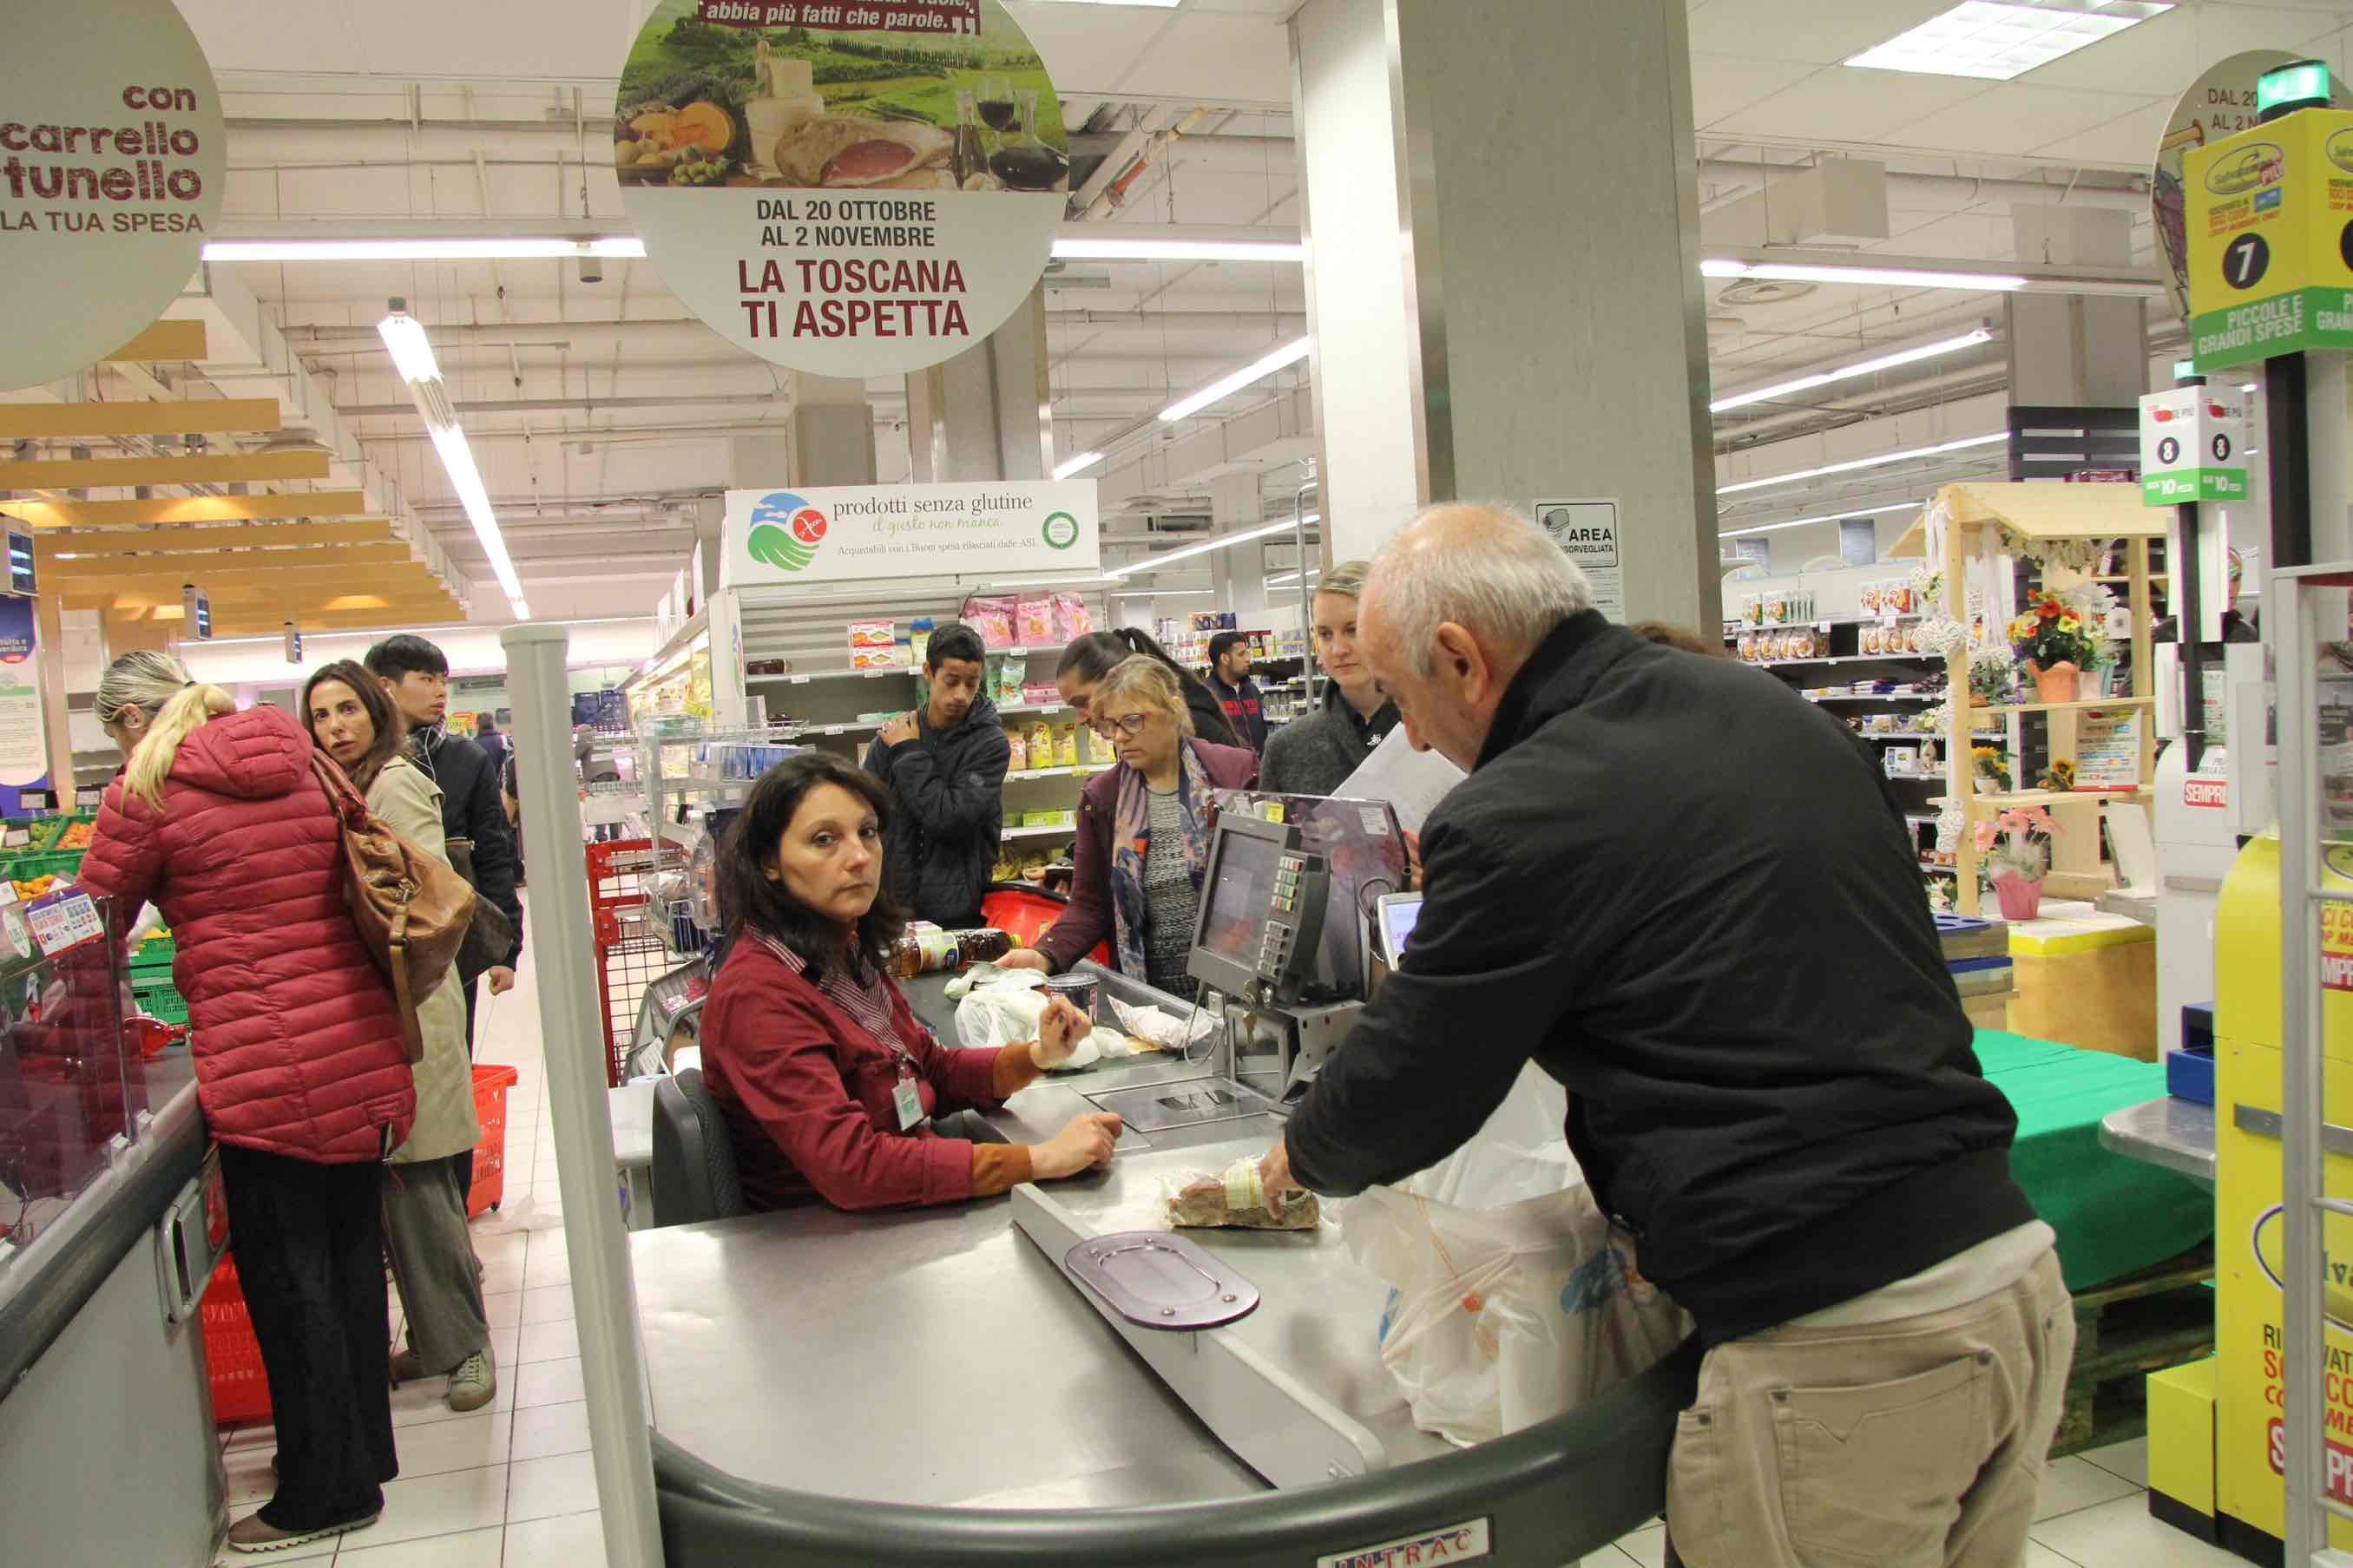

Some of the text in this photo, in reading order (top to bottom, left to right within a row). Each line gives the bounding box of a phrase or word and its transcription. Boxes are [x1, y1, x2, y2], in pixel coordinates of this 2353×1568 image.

[707, 3, 759, 21] abbia
[766, 4, 797, 24] più
[803, 5, 842, 23] fatti
[846, 8, 880, 25] che
[122, 85, 197, 112] con
[2207, 88, 2238, 105] DAL
[2212, 114, 2230, 130] AL
[2235, 115, 2244, 130] 2
[0, 121, 200, 156] carrello
[0, 155, 202, 201] tunello
[756, 200, 937, 221] DAL 20 OTTOBRE
[44, 211, 105, 233] TUA
[112, 213, 205, 233] SPESA
[760, 226, 936, 247] AL 2 NOVEMBRE
[738, 259, 967, 294] LA TOSCANA
[740, 299, 969, 338] TI ASPETTA
[2226, 297, 2289, 331] PICCOLE
[2198, 307, 2304, 356] GRANDI SPESE
[2161, 477, 2178, 495] 10
[2215, 475, 2229, 493] 10
[833, 492, 1034, 522] prodotti senza glutine
[1568, 528, 1613, 542] AREA
[1562, 543, 1614, 554] SORVEGLIATA
